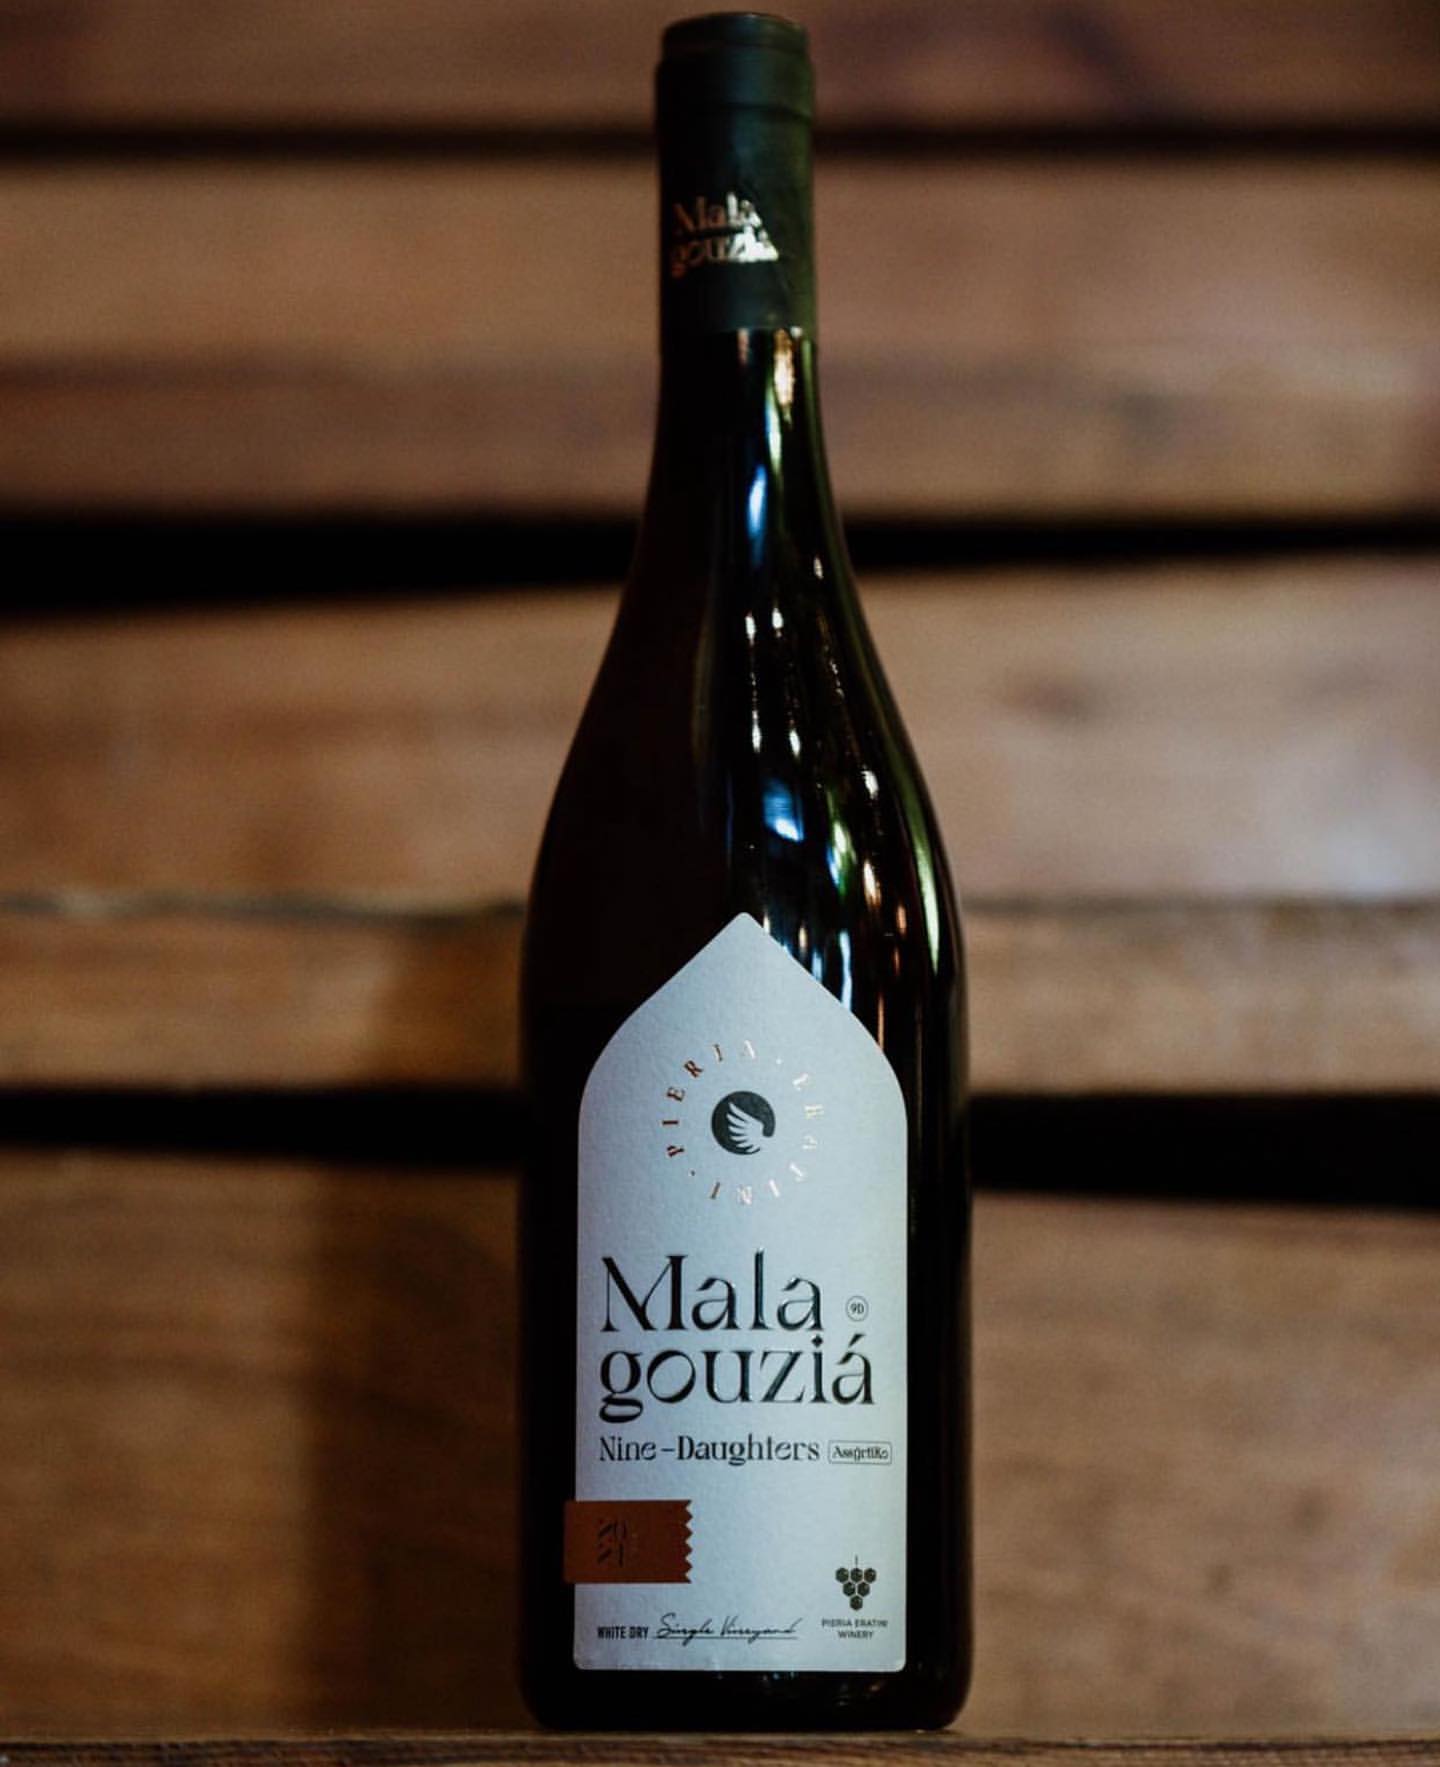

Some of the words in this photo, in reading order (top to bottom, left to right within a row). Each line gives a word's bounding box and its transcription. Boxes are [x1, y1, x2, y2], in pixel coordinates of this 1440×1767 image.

[600, 1247, 824, 1332] Mala
[598, 1333, 876, 1424] gouziá
[597, 1625, 626, 1640] WHITE
[629, 1625, 649, 1640] DRY
[655, 1612, 716, 1646] Single
